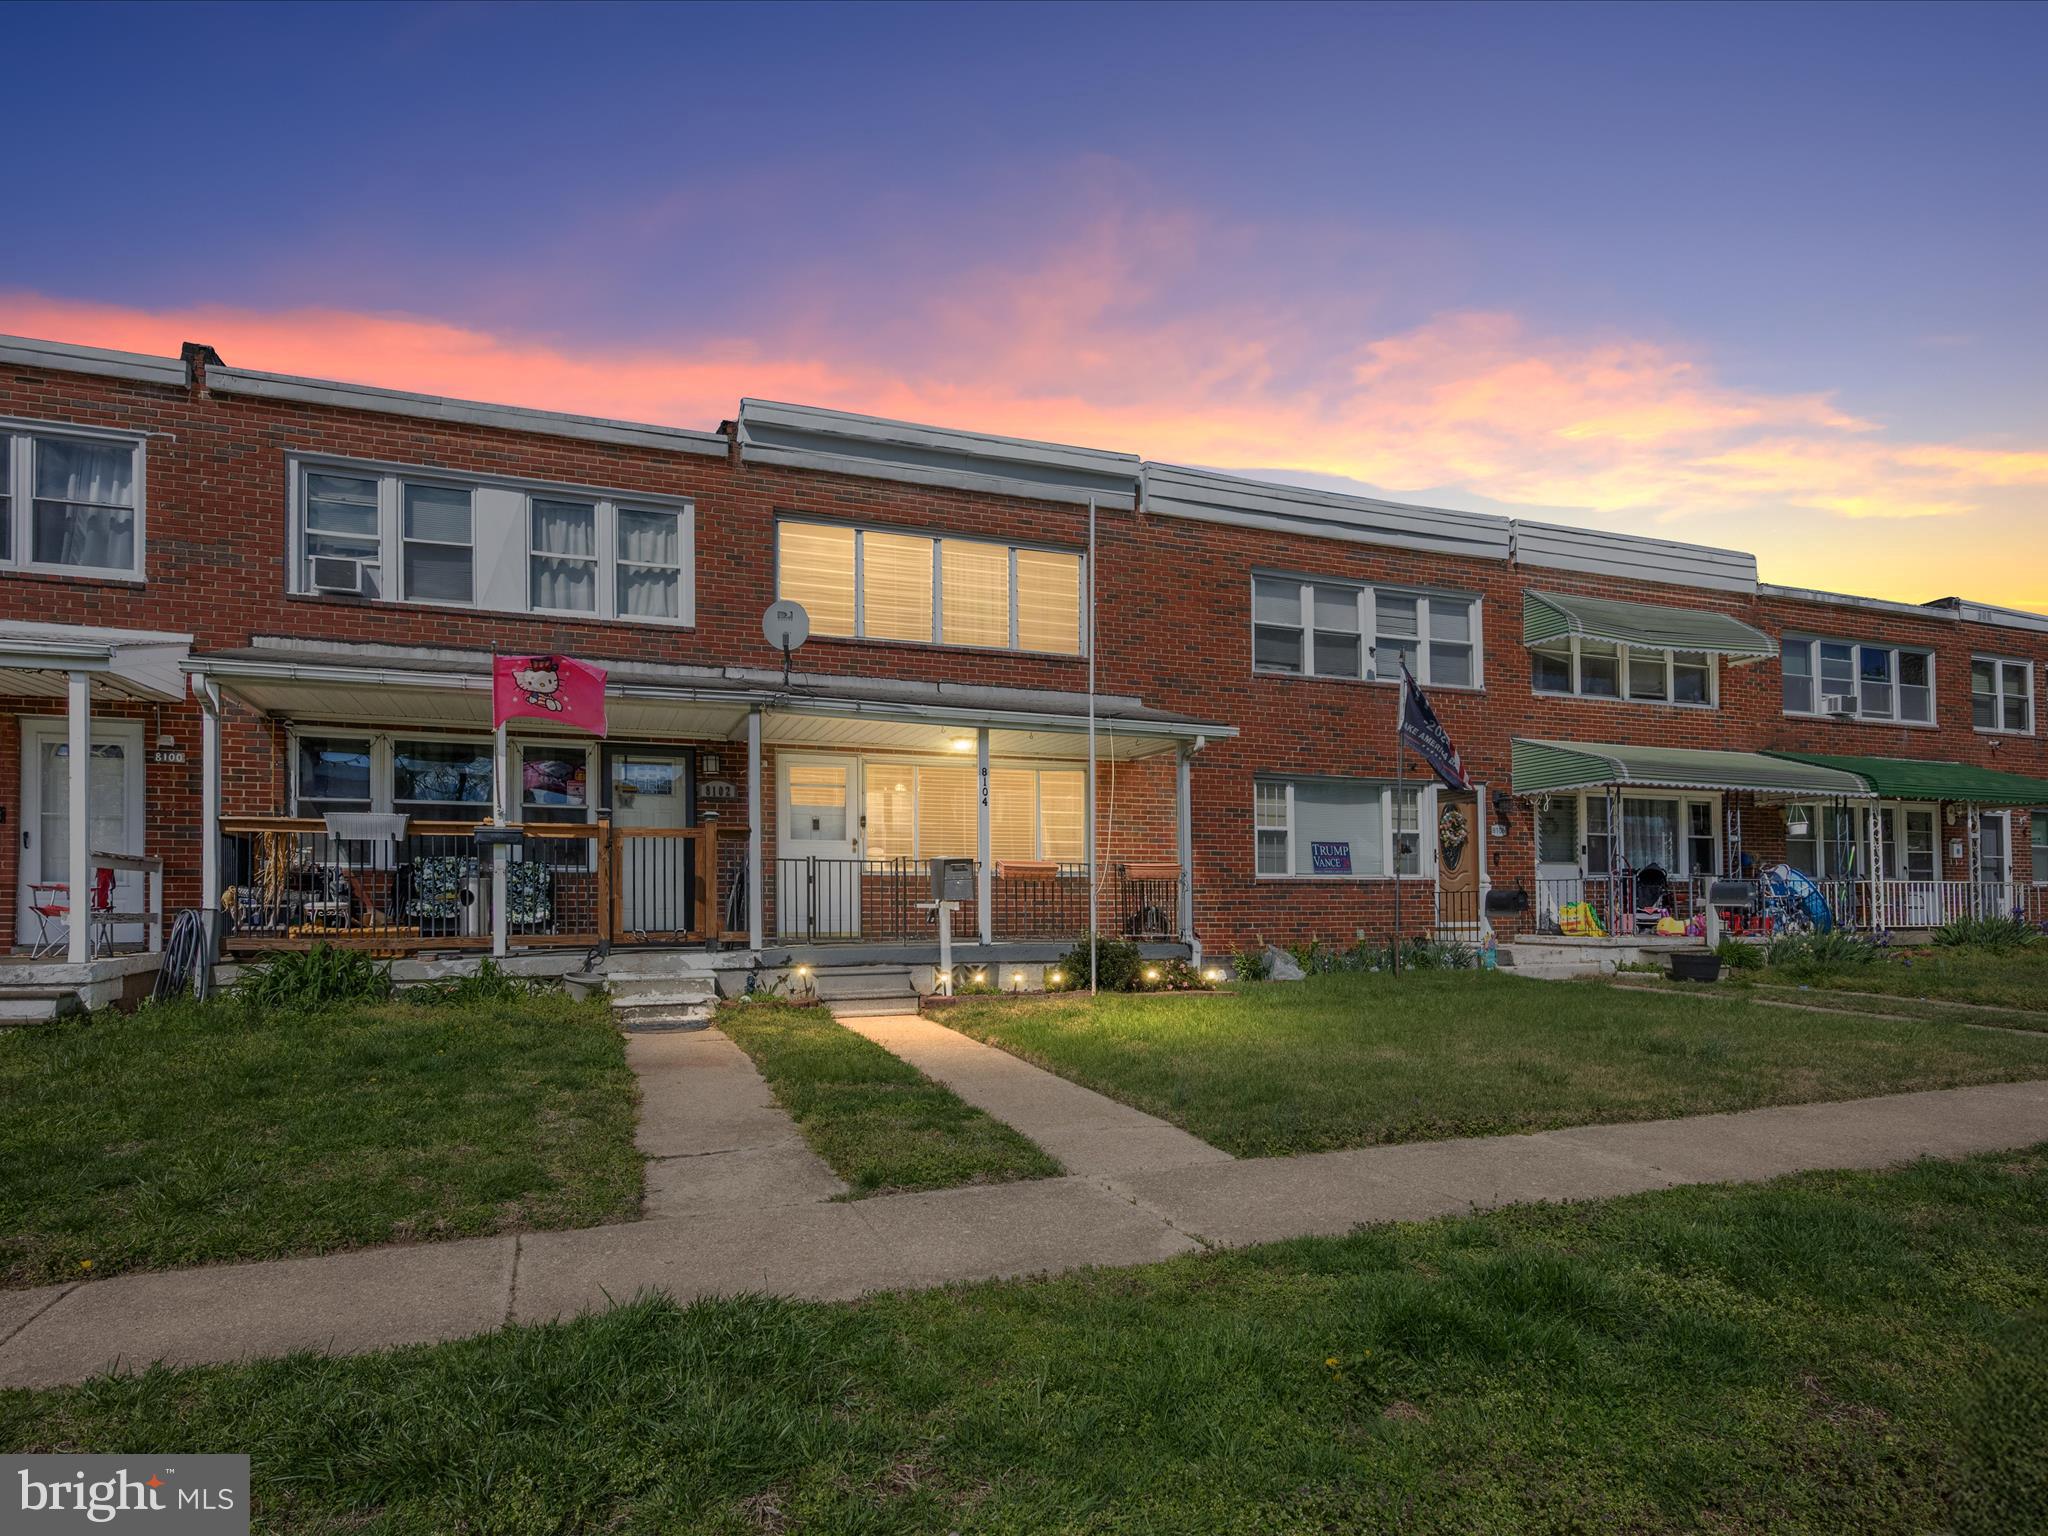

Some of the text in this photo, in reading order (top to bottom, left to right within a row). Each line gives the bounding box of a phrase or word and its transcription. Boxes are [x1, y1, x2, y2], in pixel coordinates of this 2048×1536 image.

[1418, 732, 1448, 761] AMERICA
[155, 752, 183, 762] 8100
[705, 785, 731, 796] 8102
[981, 767, 989, 807] 8104
[1312, 844, 1349, 856] TRUMP
[1313, 856, 1342, 868] VANCE
